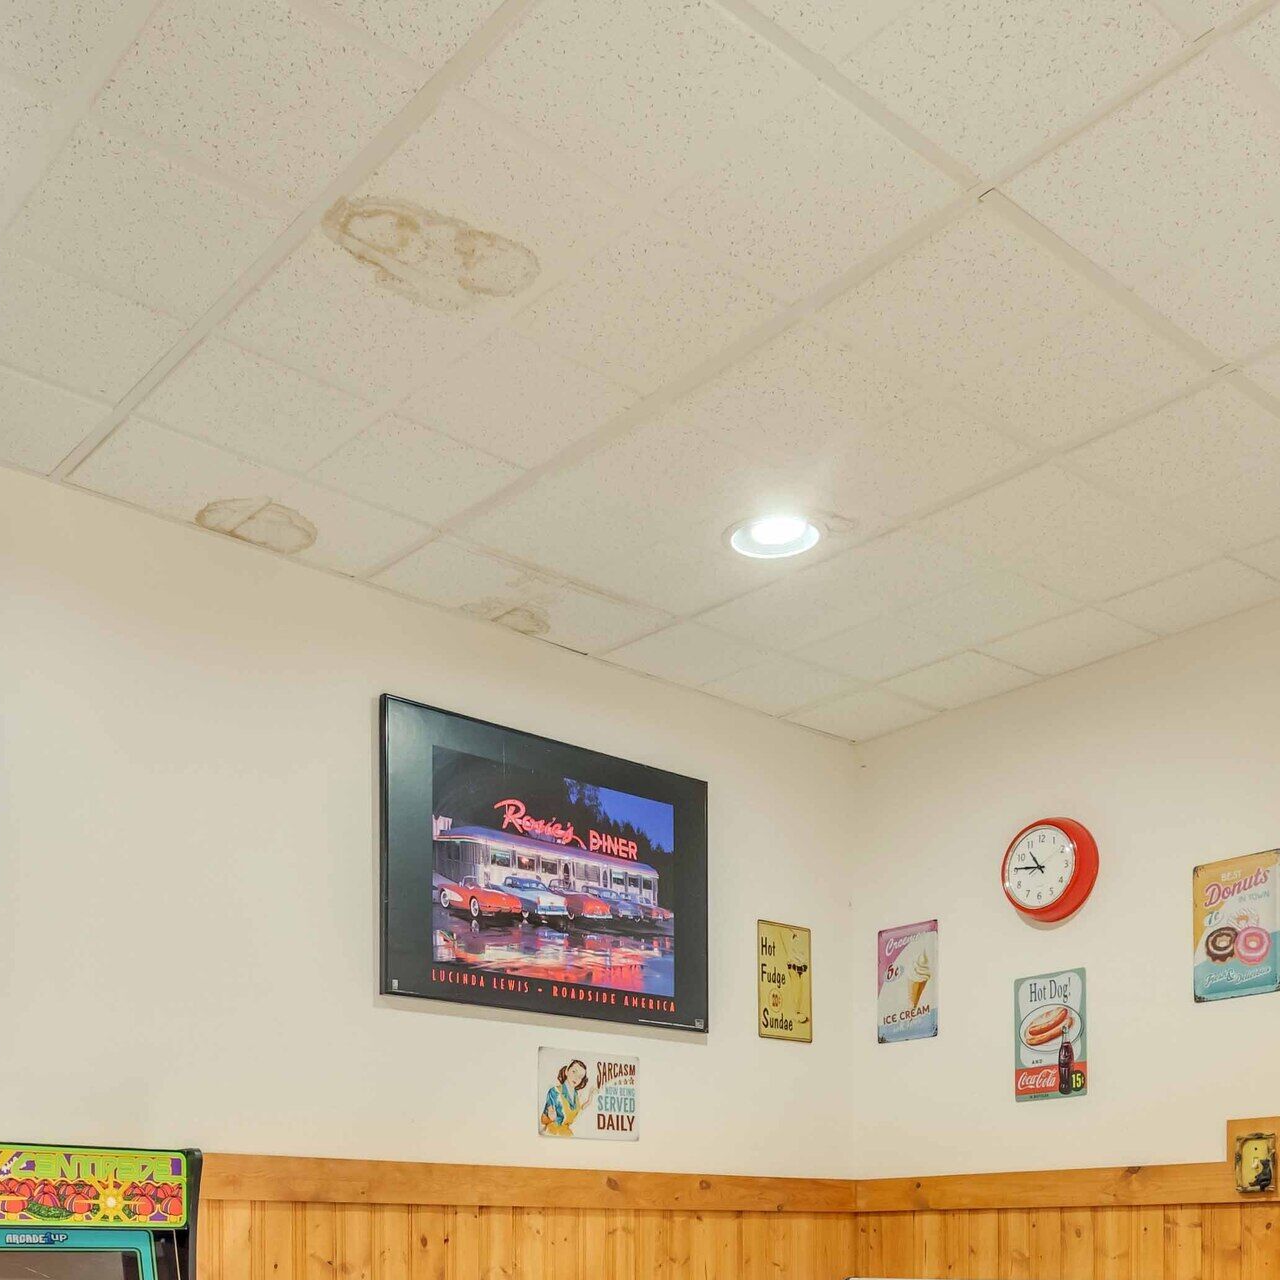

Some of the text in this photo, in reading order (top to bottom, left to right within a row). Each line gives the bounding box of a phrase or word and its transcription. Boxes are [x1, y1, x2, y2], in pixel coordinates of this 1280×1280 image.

[589, 829, 638, 860] DINER
[1027, 841, 1034, 849] 11
[1038, 834, 1046, 843] 12
[1018, 853, 1026, 862] 10
[1064, 859, 1069, 868] 3
[1017, 880, 1022, 889] 8
[1025, 889, 1031, 898] 7
[1203, 866, 1270, 907] Donuts
[1036, 891, 1042, 900] 6
[761, 937, 776, 957] Hot
[761, 963, 786, 988] Fudge
[431, 969, 485, 987] LUCINDA
[493, 979, 529, 993] LEWIS
[552, 986, 616, 1005] ROADSIDE
[623, 996, 676, 1013] AMERICA
[1029, 977, 1071, 1003] Hot Dog!
[762, 1007, 793, 1031] Sundae
[883, 1004, 930, 1025] ICE CREAM
[597, 1061, 636, 1089] SARCASM
[598, 1095, 635, 1113] SERVED
[597, 1113, 635, 1131] DAILY
[12, 1151, 173, 1180] CENTIPEDE
